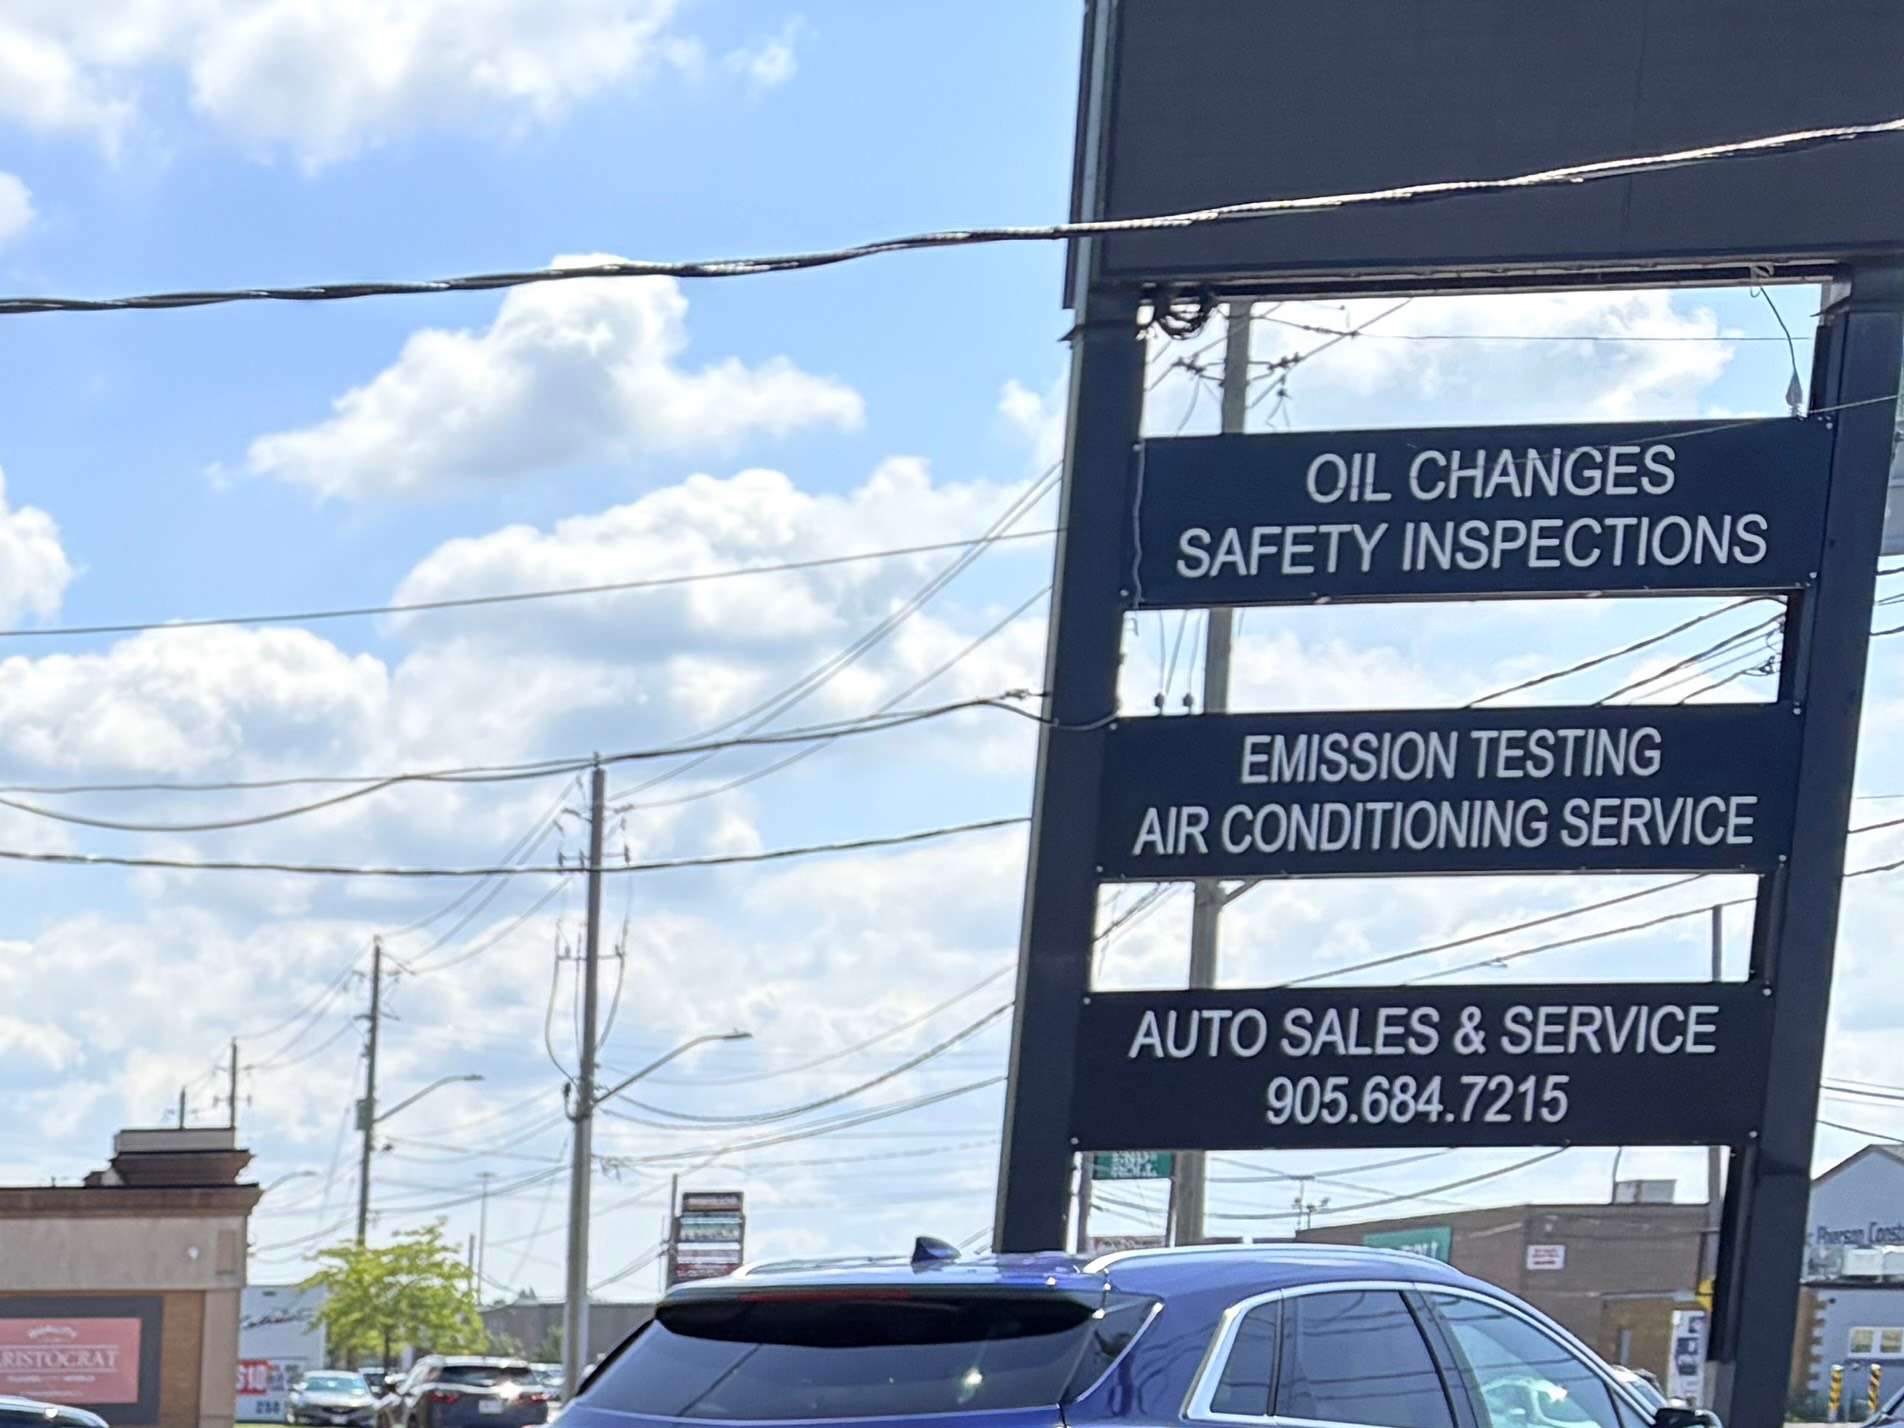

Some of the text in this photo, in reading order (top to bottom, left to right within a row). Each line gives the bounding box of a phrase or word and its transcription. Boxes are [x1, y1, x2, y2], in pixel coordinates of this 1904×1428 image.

[1305, 444, 1677, 503] OIL CHANGES
[1176, 513, 1769, 579] SAFETY INSPECTIONS
[1241, 727, 1663, 784] EMISSION TESTING
[1132, 795, 1759, 856] AIR CONDITIONING SERVICE
[1128, 1004, 1720, 1060] AUTO SALES & SERVICE
[1265, 1075, 1571, 1125] 905.684.7215
